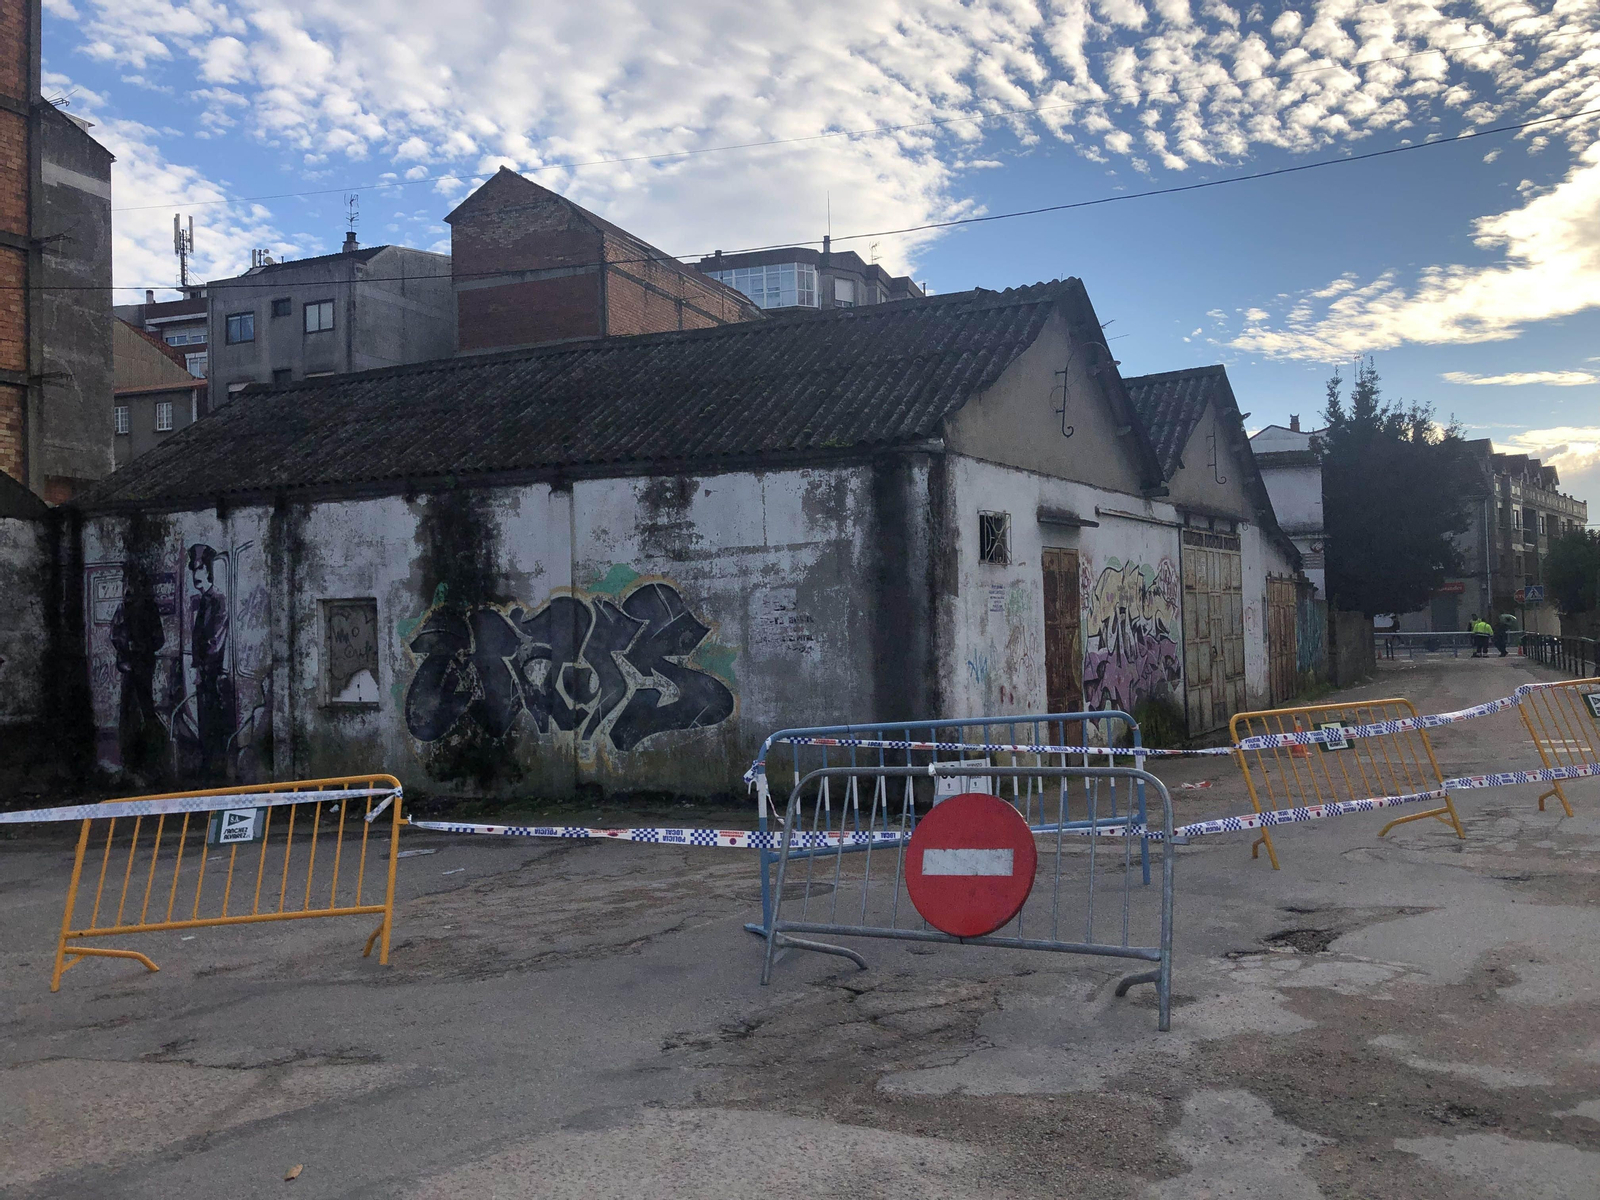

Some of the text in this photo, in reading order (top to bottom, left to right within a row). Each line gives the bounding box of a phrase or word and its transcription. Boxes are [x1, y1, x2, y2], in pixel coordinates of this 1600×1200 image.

[534, 828, 558, 836] POLICIA
[1205, 825, 1221, 833] POLICIA
[662, 835, 686, 843] POLICIA
